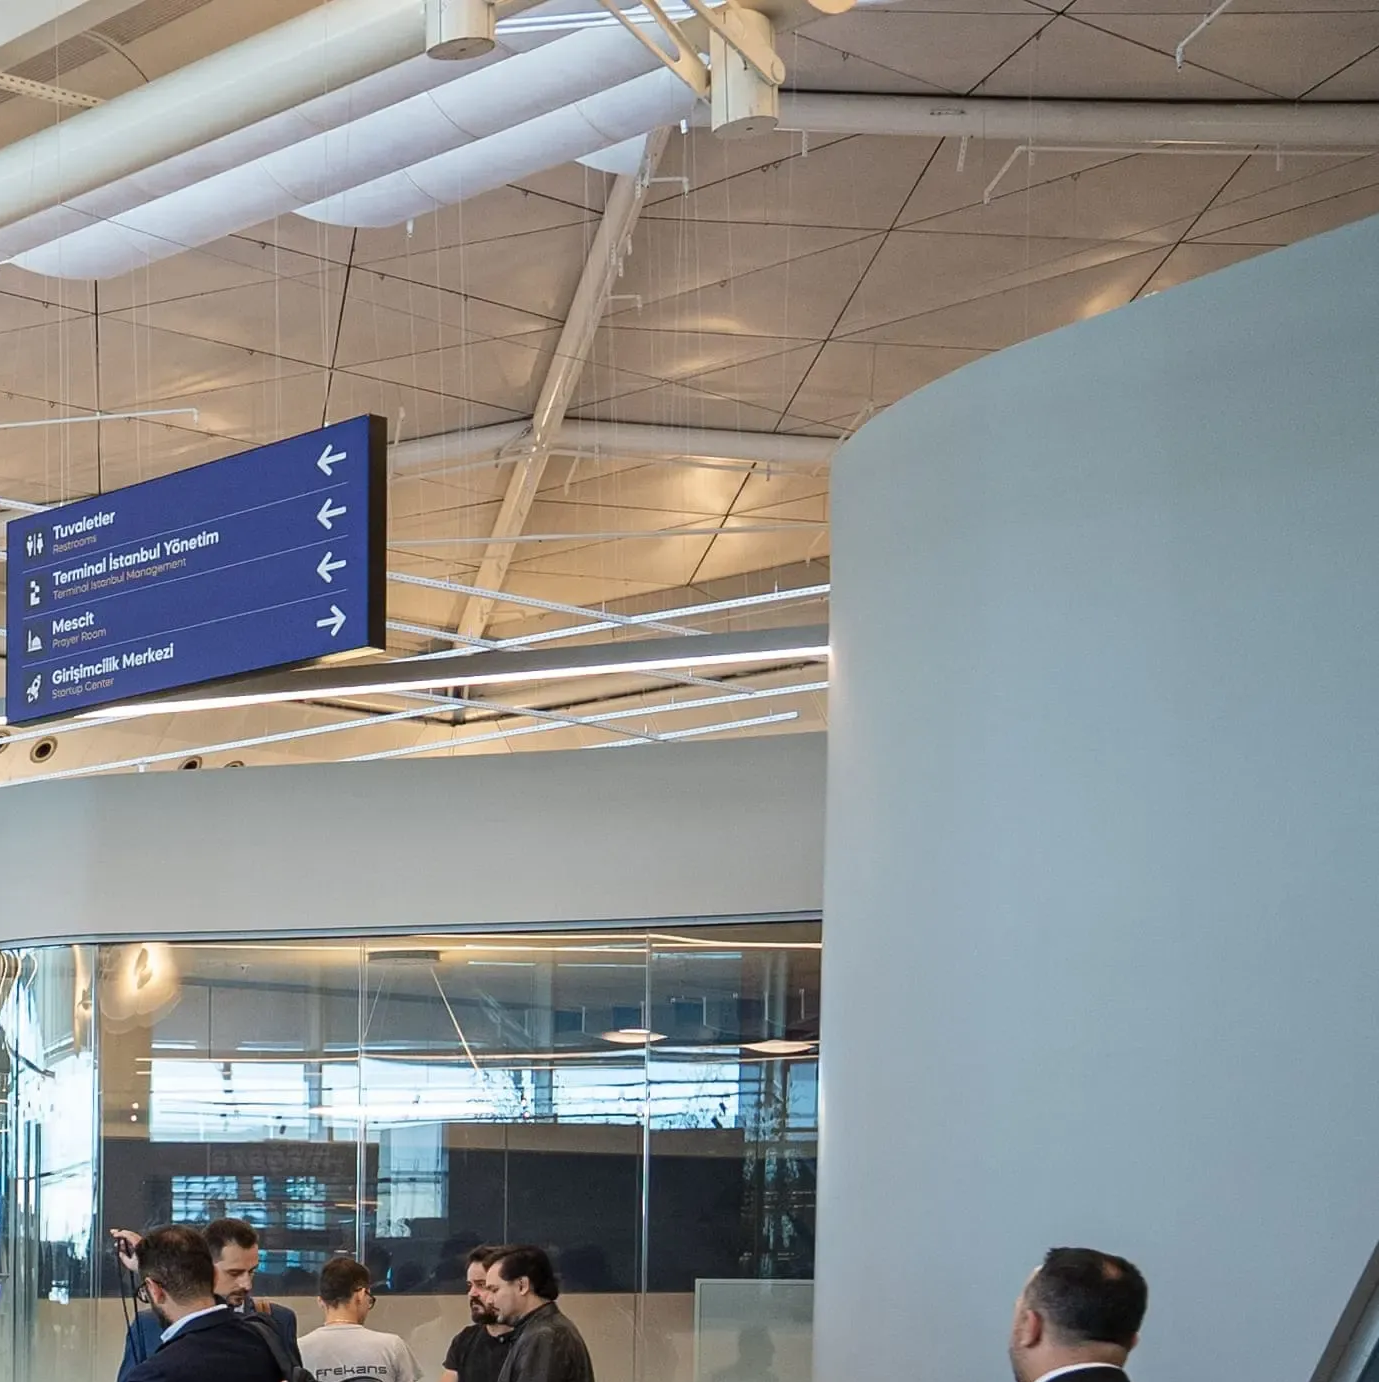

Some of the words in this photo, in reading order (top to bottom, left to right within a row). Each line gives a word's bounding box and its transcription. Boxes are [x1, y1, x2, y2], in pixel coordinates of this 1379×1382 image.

[53, 511, 116, 540] Tuvaletler
[53, 535, 97, 555] Restrooms
[53, 557, 107, 586] Terminal
[109, 543, 161, 571] İstanbul
[163, 530, 220, 556] Yönetim
[53, 582, 90, 600] Terminal
[126, 557, 187, 581] Management
[52, 611, 95, 635] Mescit
[52, 635, 79, 649] Prayer
[81, 628, 107, 642] Room
[52, 656, 120, 685] Girişimcilik
[122, 642, 174, 669] Merkezi
[52, 684, 83, 699] Startup
[85, 678, 115, 692] Center
